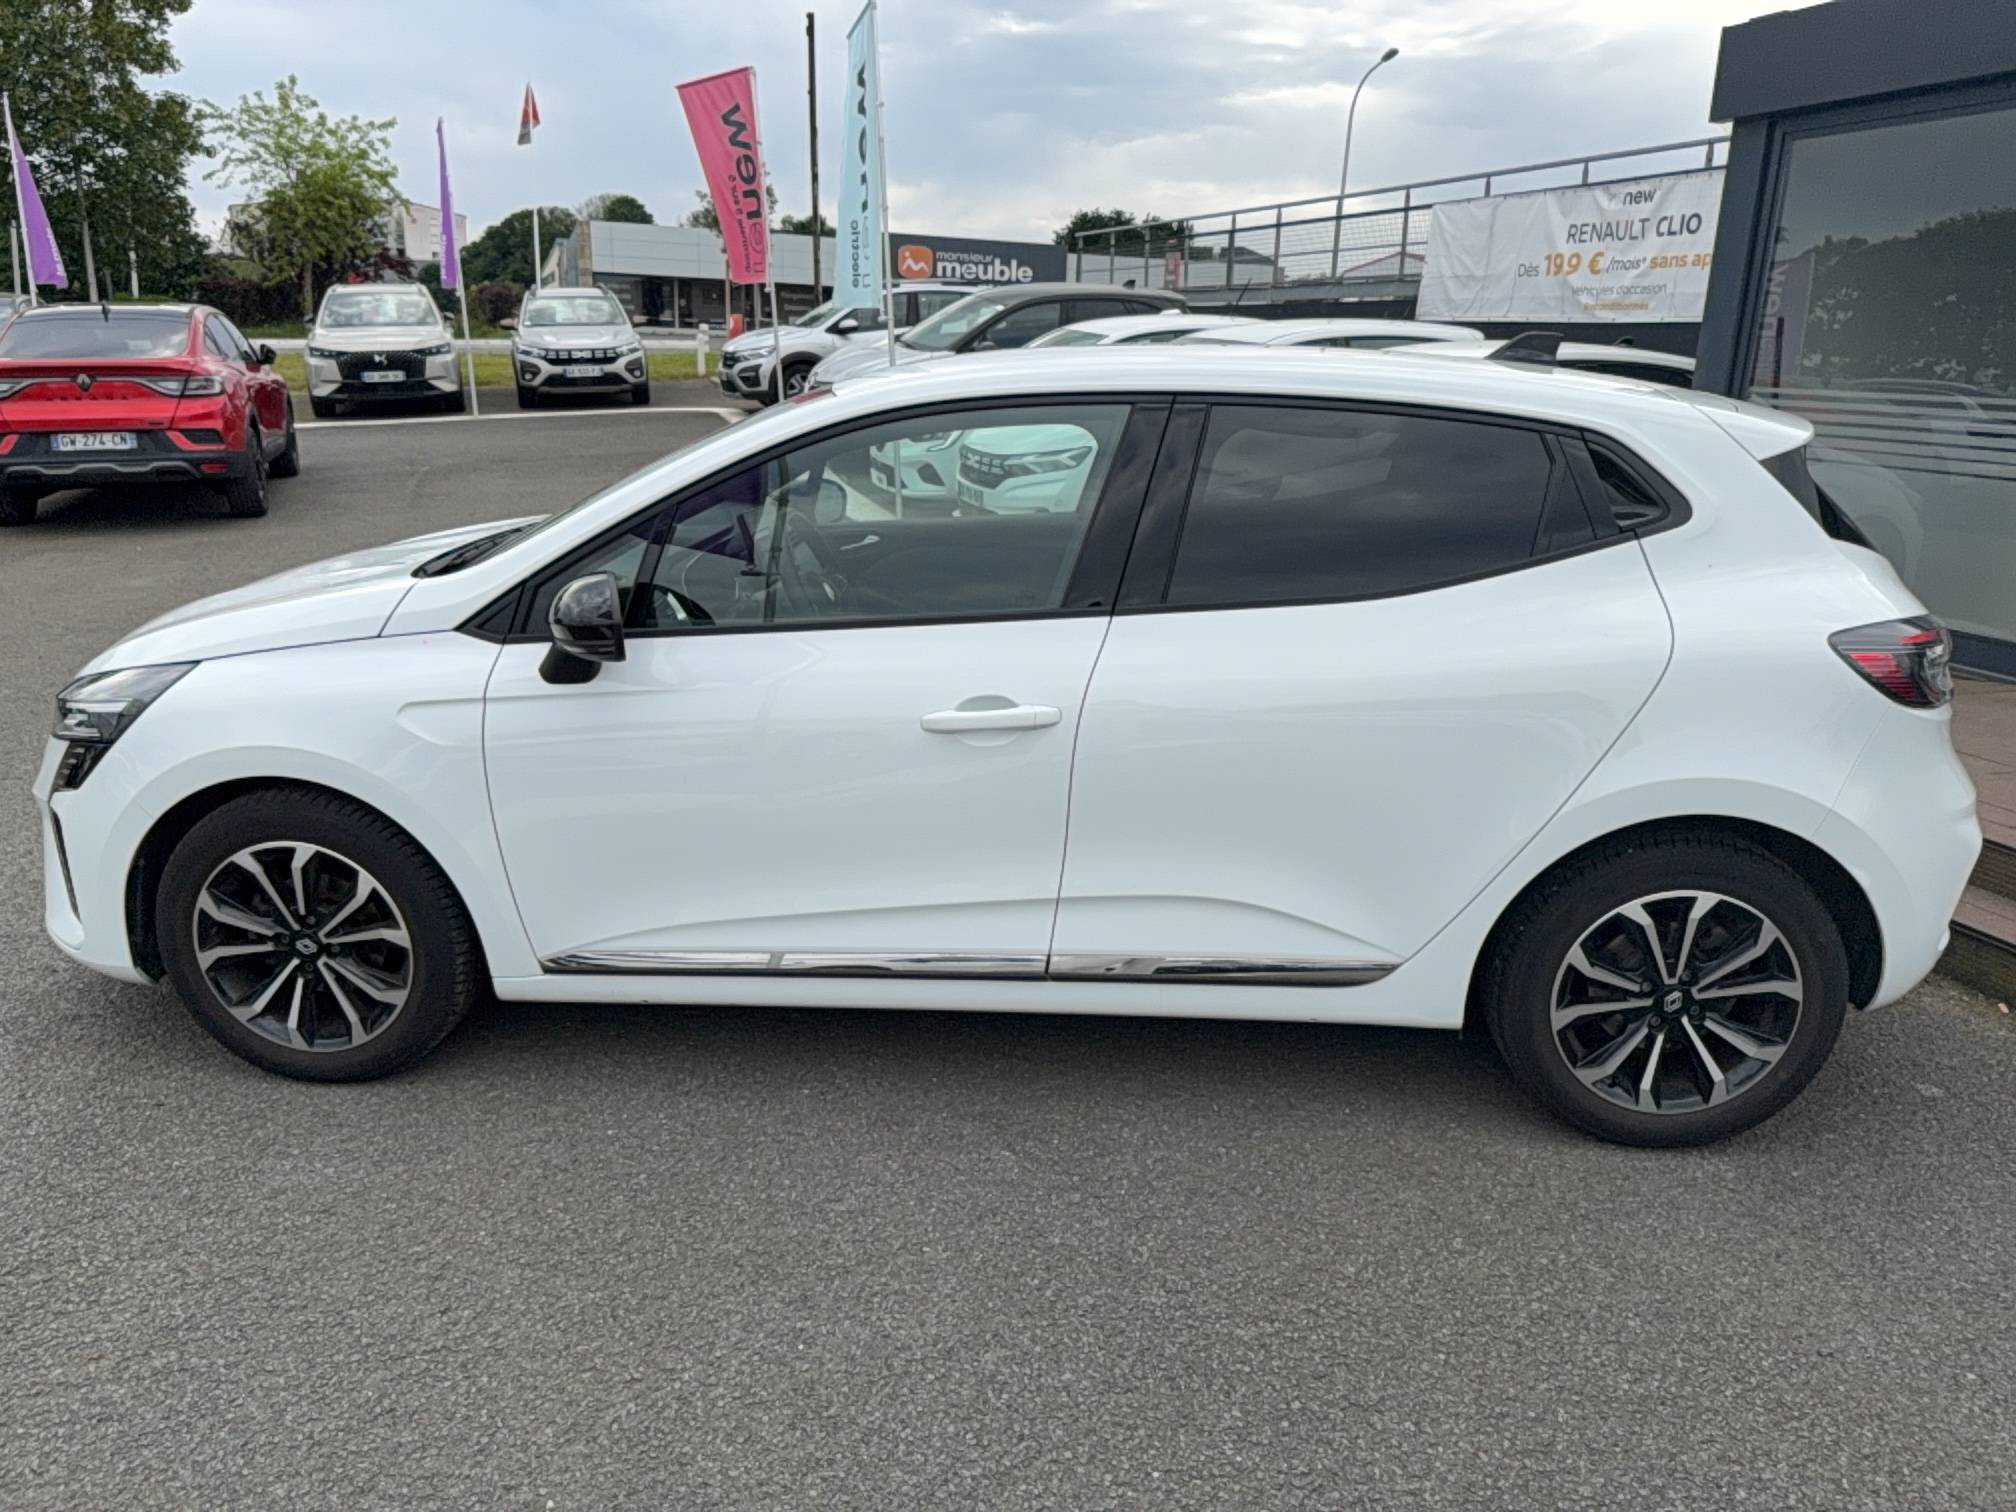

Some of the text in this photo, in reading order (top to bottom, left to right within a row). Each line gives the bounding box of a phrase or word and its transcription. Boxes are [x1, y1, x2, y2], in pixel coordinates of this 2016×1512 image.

[1622, 187, 1657, 206] new
[1566, 212, 1703, 245] RENAULT CLIO
[936, 251, 993, 263] monsieur
[1518, 261, 1540, 278] Dès
[1544, 252, 1582, 277] 199
[1588, 251, 1605, 275] €
[1650, 255, 1688, 269] sans
[936, 258, 1033, 282] meuble
[61, 432, 129, 448] GW-274-CN
